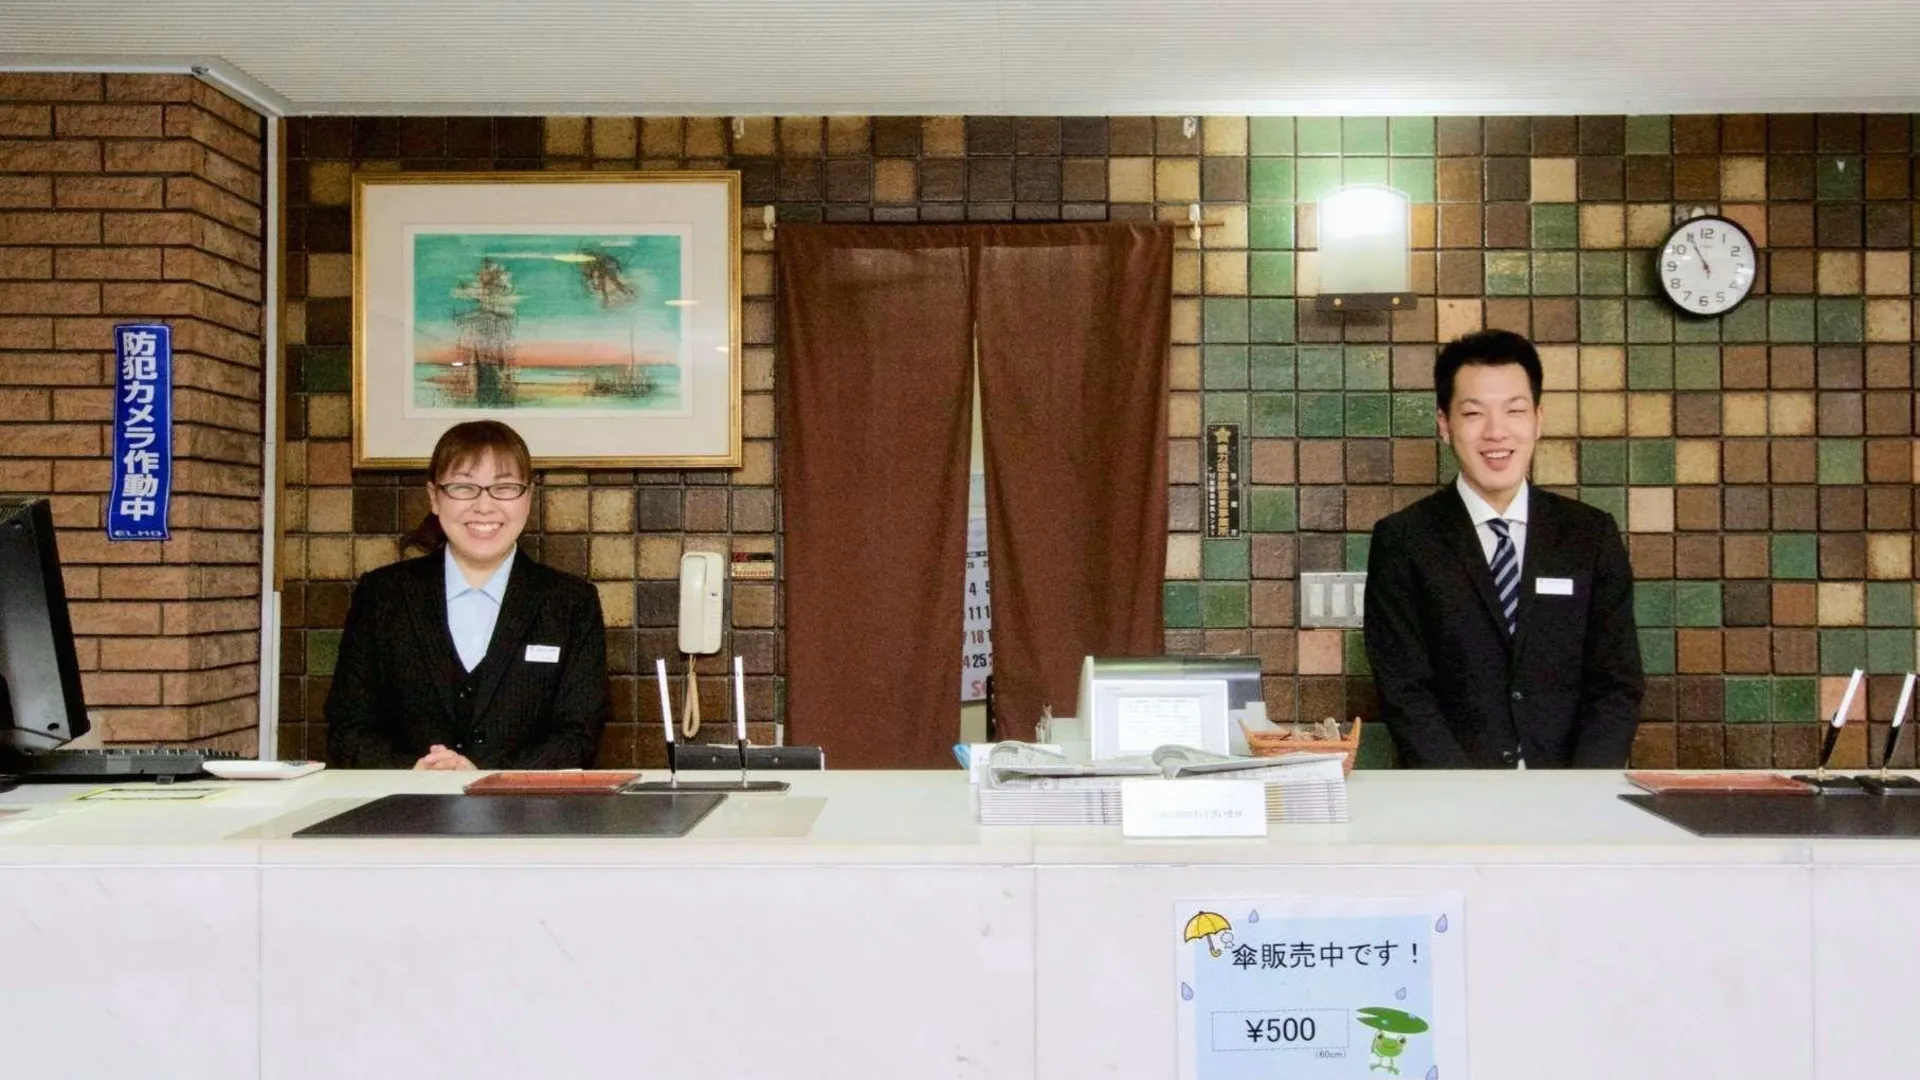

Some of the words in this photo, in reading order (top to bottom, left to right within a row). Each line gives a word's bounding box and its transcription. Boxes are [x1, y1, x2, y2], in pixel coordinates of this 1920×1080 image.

[1700, 228, 1715, 239] 12
[1722, 233, 1726, 244] 1
[1672, 244, 1687, 255] 10
[1730, 246, 1740, 257] 2
[1667, 261, 1677, 272] 9
[1670, 278, 1681, 289] 8
[1683, 290, 1692, 301] 7
[1699, 296, 1709, 306] 6
[1716, 291, 1725, 303] 5
[120, 331, 159, 521] 防犯カメラ作動中
[969, 582, 976, 595] 4
[969, 606, 981, 620] 11
[971, 630, 984, 644] 18
[972, 653, 987, 668] 25
[1232, 939, 1419, 970] 傘販売中です！
[1245, 1016, 1316, 1043] ¥500
